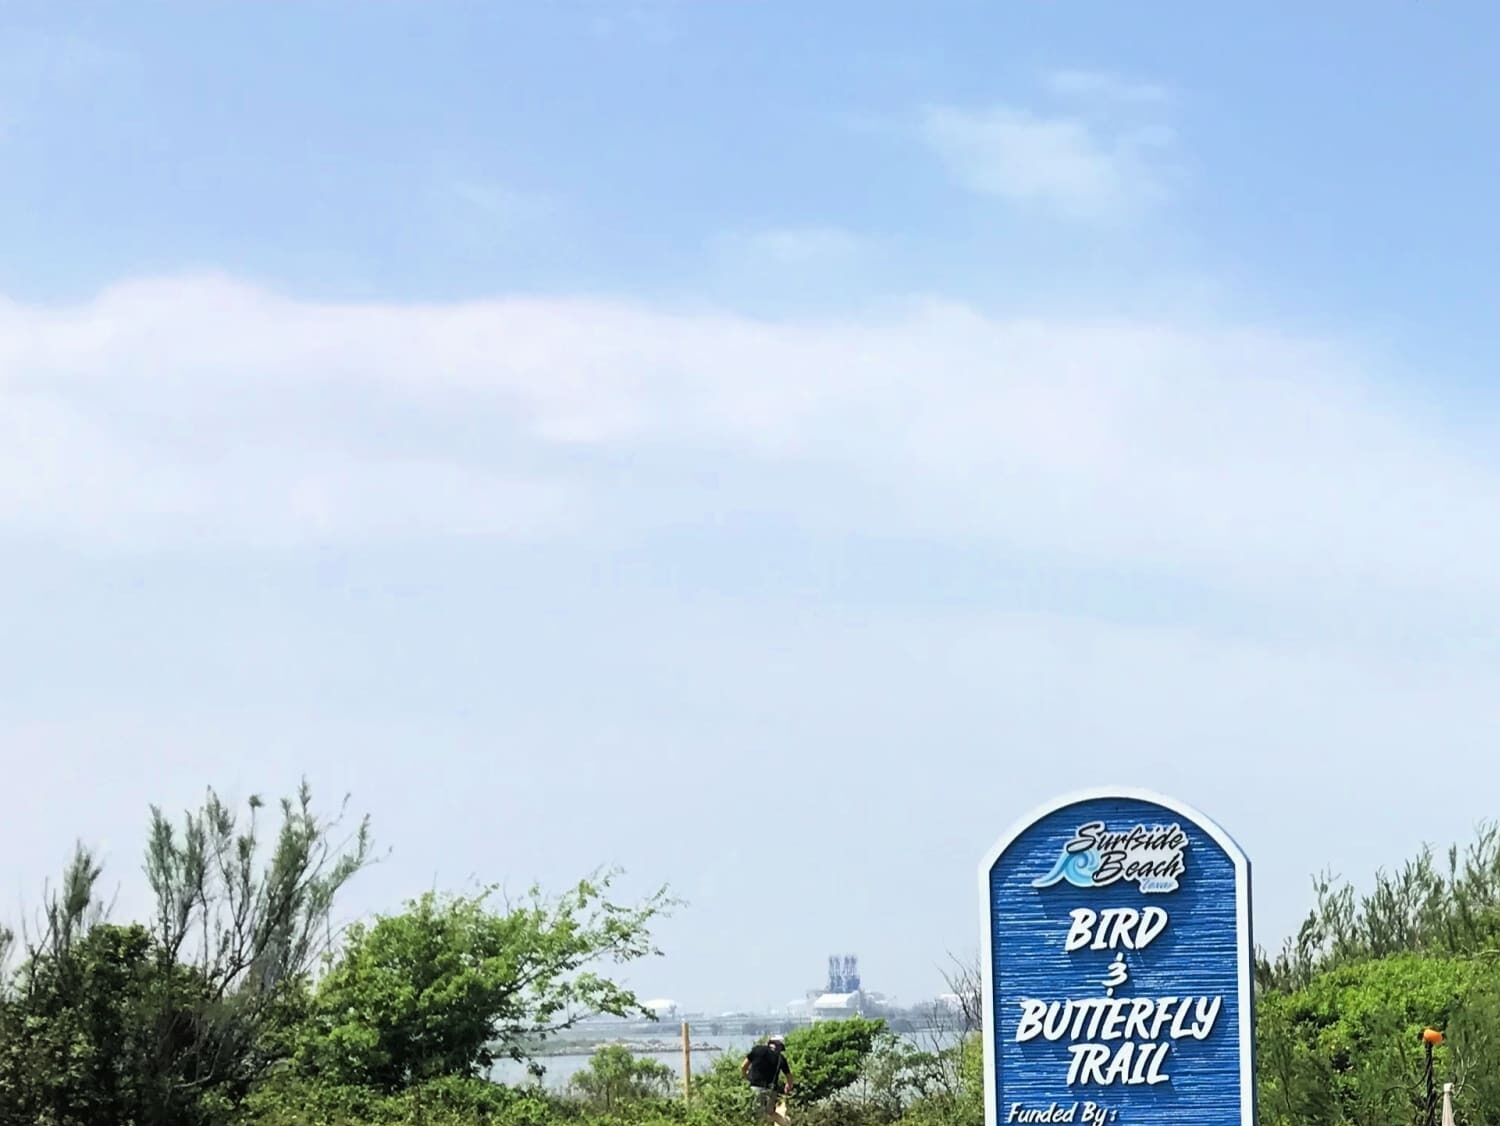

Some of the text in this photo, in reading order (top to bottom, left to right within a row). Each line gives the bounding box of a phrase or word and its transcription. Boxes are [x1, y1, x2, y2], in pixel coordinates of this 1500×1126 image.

[1066, 823, 1184, 854] Surfside
[1092, 850, 1181, 882] Beach
[1064, 906, 1168, 951] BIRD
[1015, 996, 1222, 1043] BUTTERFLY
[1066, 1041, 1170, 1086] TRAIL
[1008, 1101, 1079, 1124] Funded
